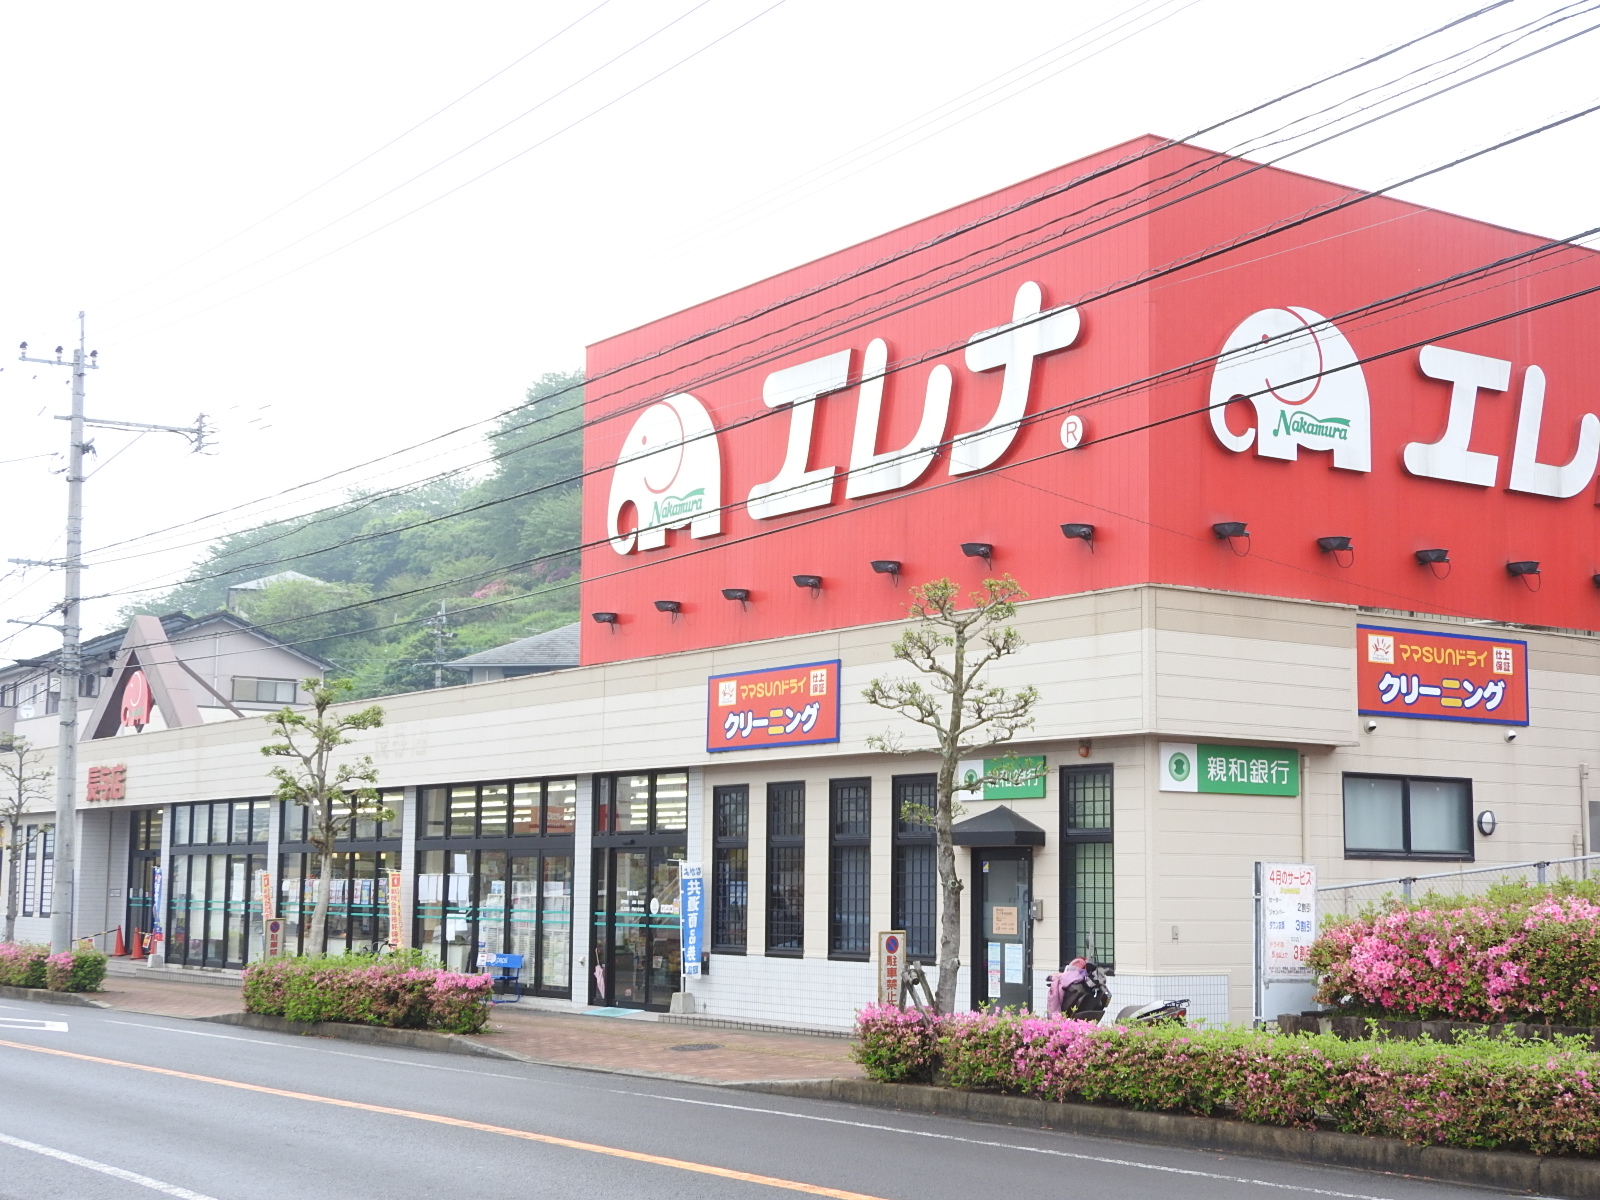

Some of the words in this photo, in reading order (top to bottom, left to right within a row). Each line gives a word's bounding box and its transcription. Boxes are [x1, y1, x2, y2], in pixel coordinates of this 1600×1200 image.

[747, 281, 1081, 520] エレナ
[1272, 409, 1348, 440] Nakamura
[648, 494, 703, 528] Nakamura
[1378, 672, 1506, 711] クリーニング
[724, 701, 820, 740] クリーニング
[1207, 756, 1290, 785] 親和銀行
[1269, 869, 1313, 886] 4月のサービス
[886, 955, 898, 1004] 駐車禁止
